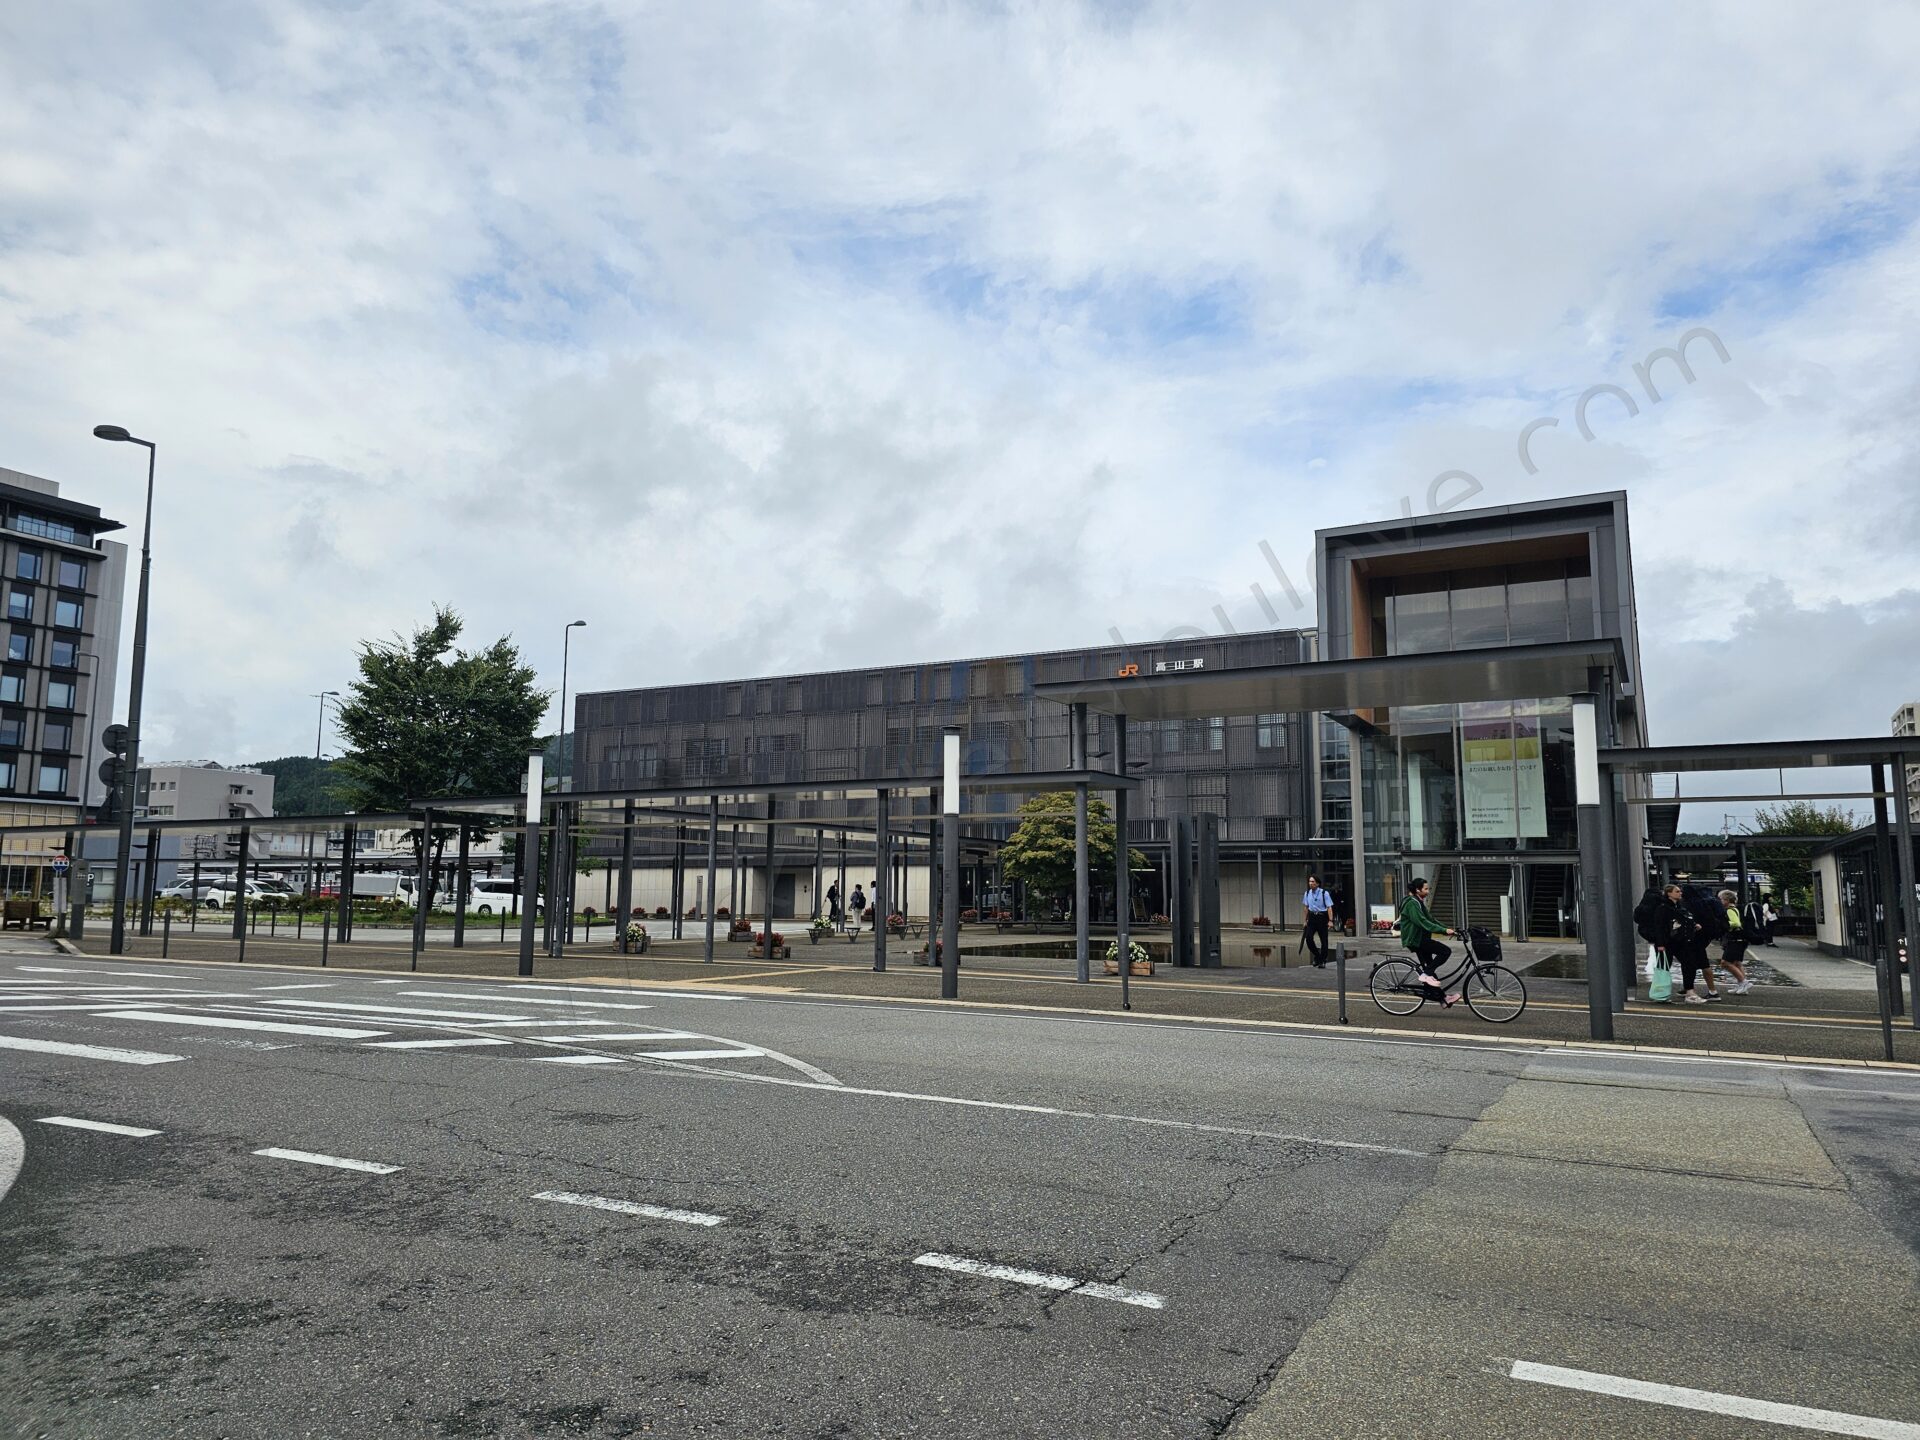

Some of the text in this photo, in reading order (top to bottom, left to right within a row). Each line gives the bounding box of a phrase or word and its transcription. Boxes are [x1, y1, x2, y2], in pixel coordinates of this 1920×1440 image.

[1118, 664, 1139, 677] JR
[1156, 658, 1204, 672] 高山駅
